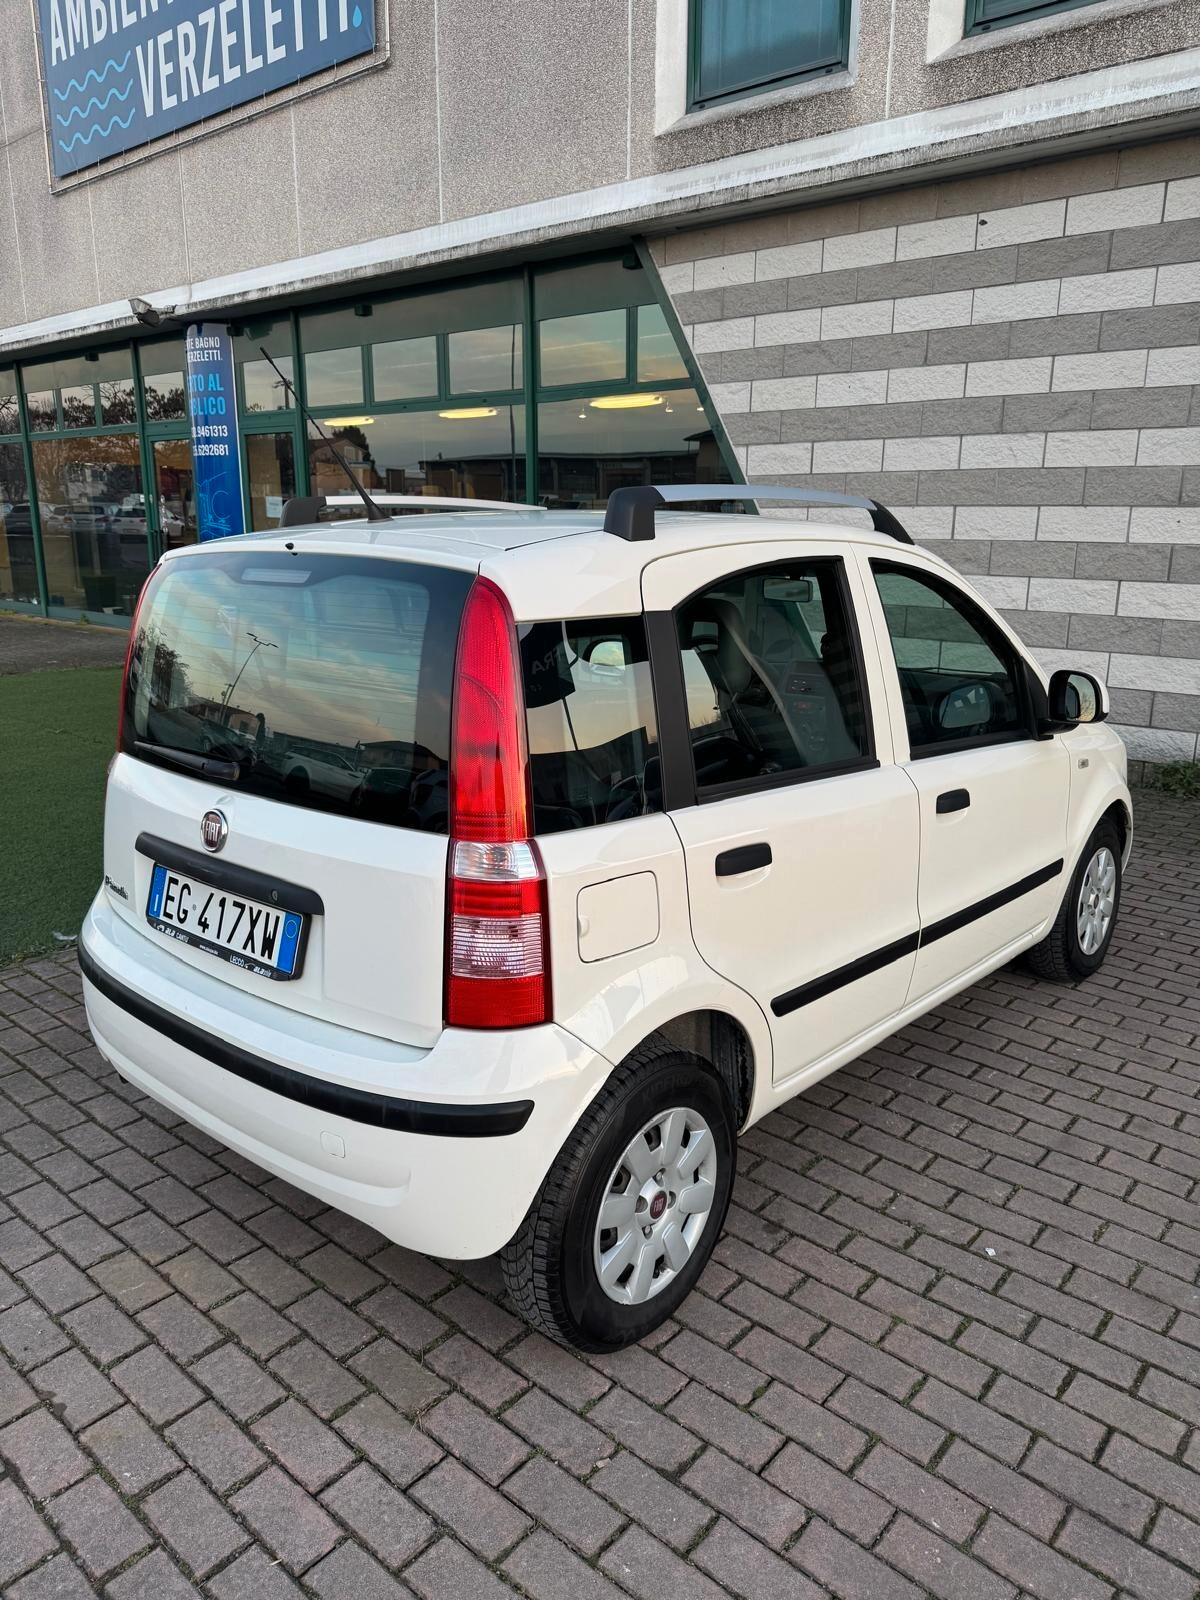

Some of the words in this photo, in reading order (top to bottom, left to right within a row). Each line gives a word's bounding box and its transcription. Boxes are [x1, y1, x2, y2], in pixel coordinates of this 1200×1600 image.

[195, 336, 220, 349] BAGNO
[190, 374, 205, 392] TO
[208, 373, 224, 391] AL
[204, 820, 221, 842] FIAT
[162, 875, 192, 925] EG
[197, 891, 281, 961] 417XW
